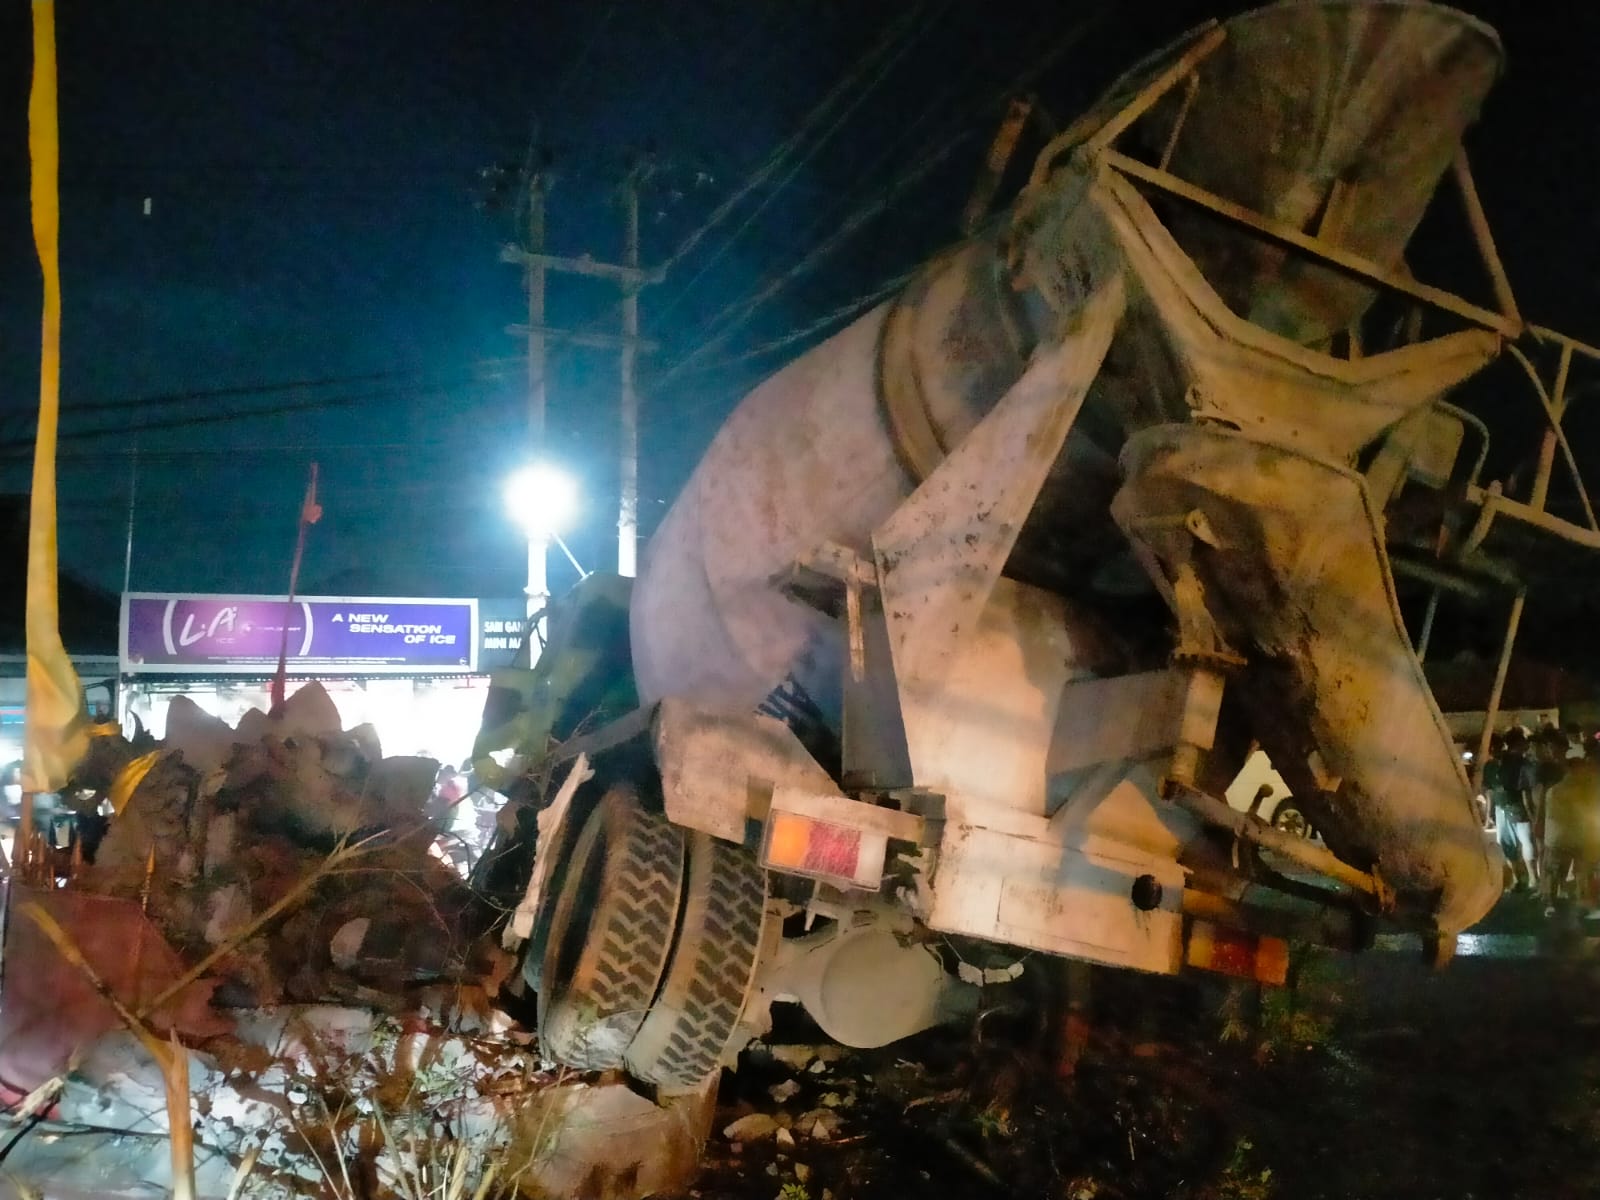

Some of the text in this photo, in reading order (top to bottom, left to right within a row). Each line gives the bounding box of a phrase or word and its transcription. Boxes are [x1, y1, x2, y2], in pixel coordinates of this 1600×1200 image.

[332, 613, 389, 623] A NEW
[349, 624, 442, 634] SENSATION
[404, 634, 456, 645] OF ICE
